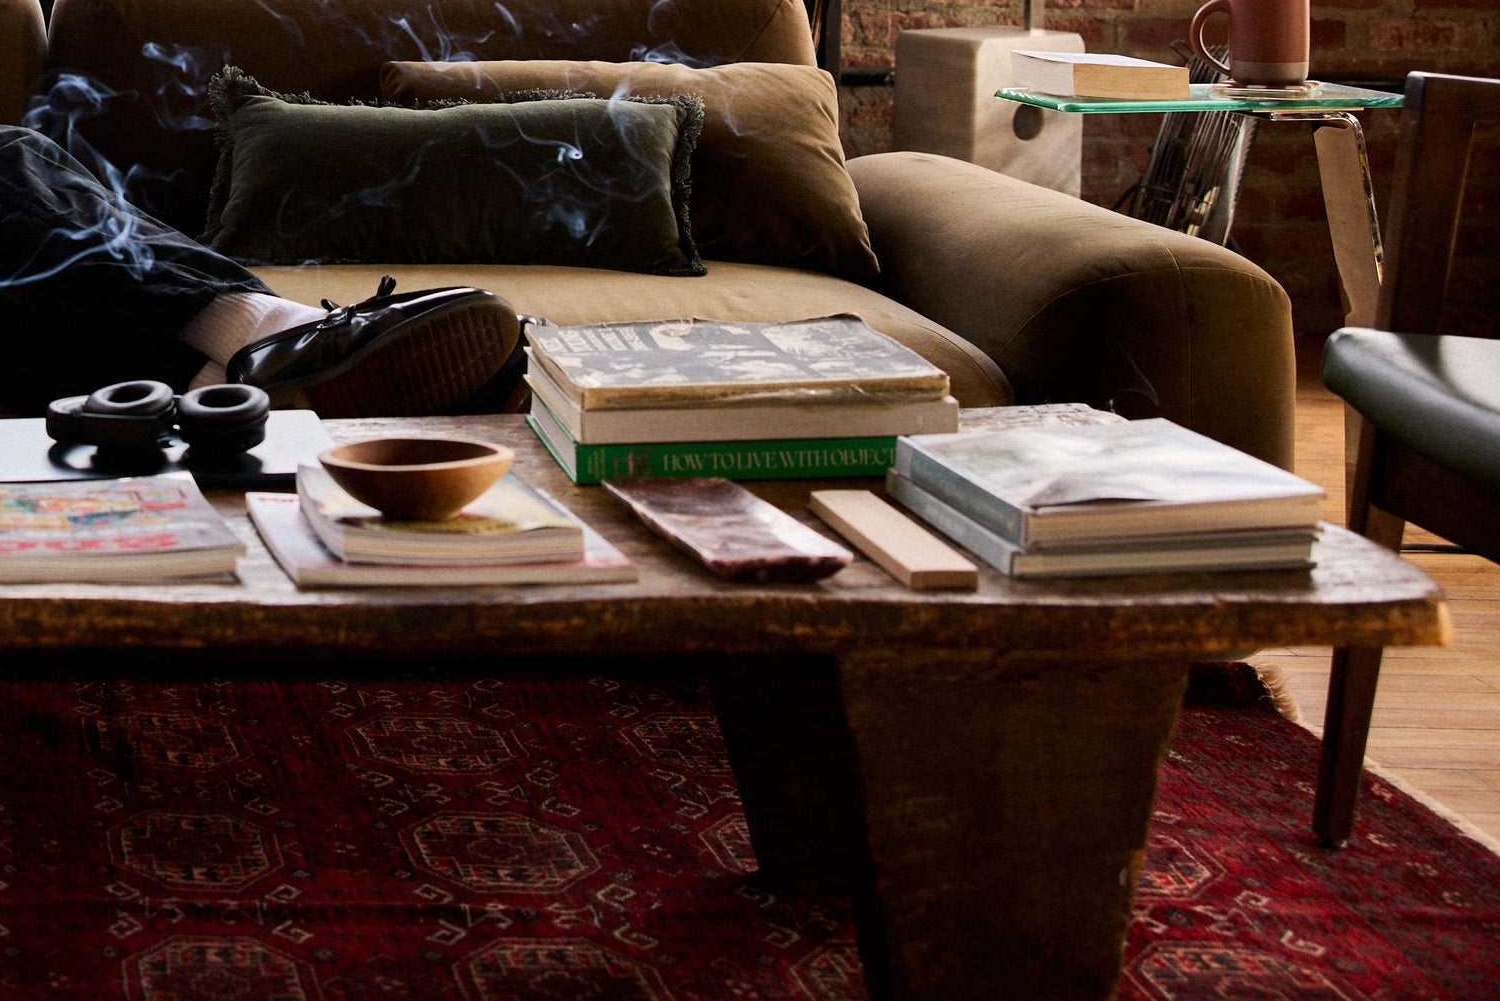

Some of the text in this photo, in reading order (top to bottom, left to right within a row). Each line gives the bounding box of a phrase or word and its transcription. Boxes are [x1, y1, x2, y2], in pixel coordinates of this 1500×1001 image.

[663, 453, 706, 472] HOW
[706, 452, 734, 470] TO
[737, 450, 778, 469] LIVE
[779, 449, 828, 468] WITH
